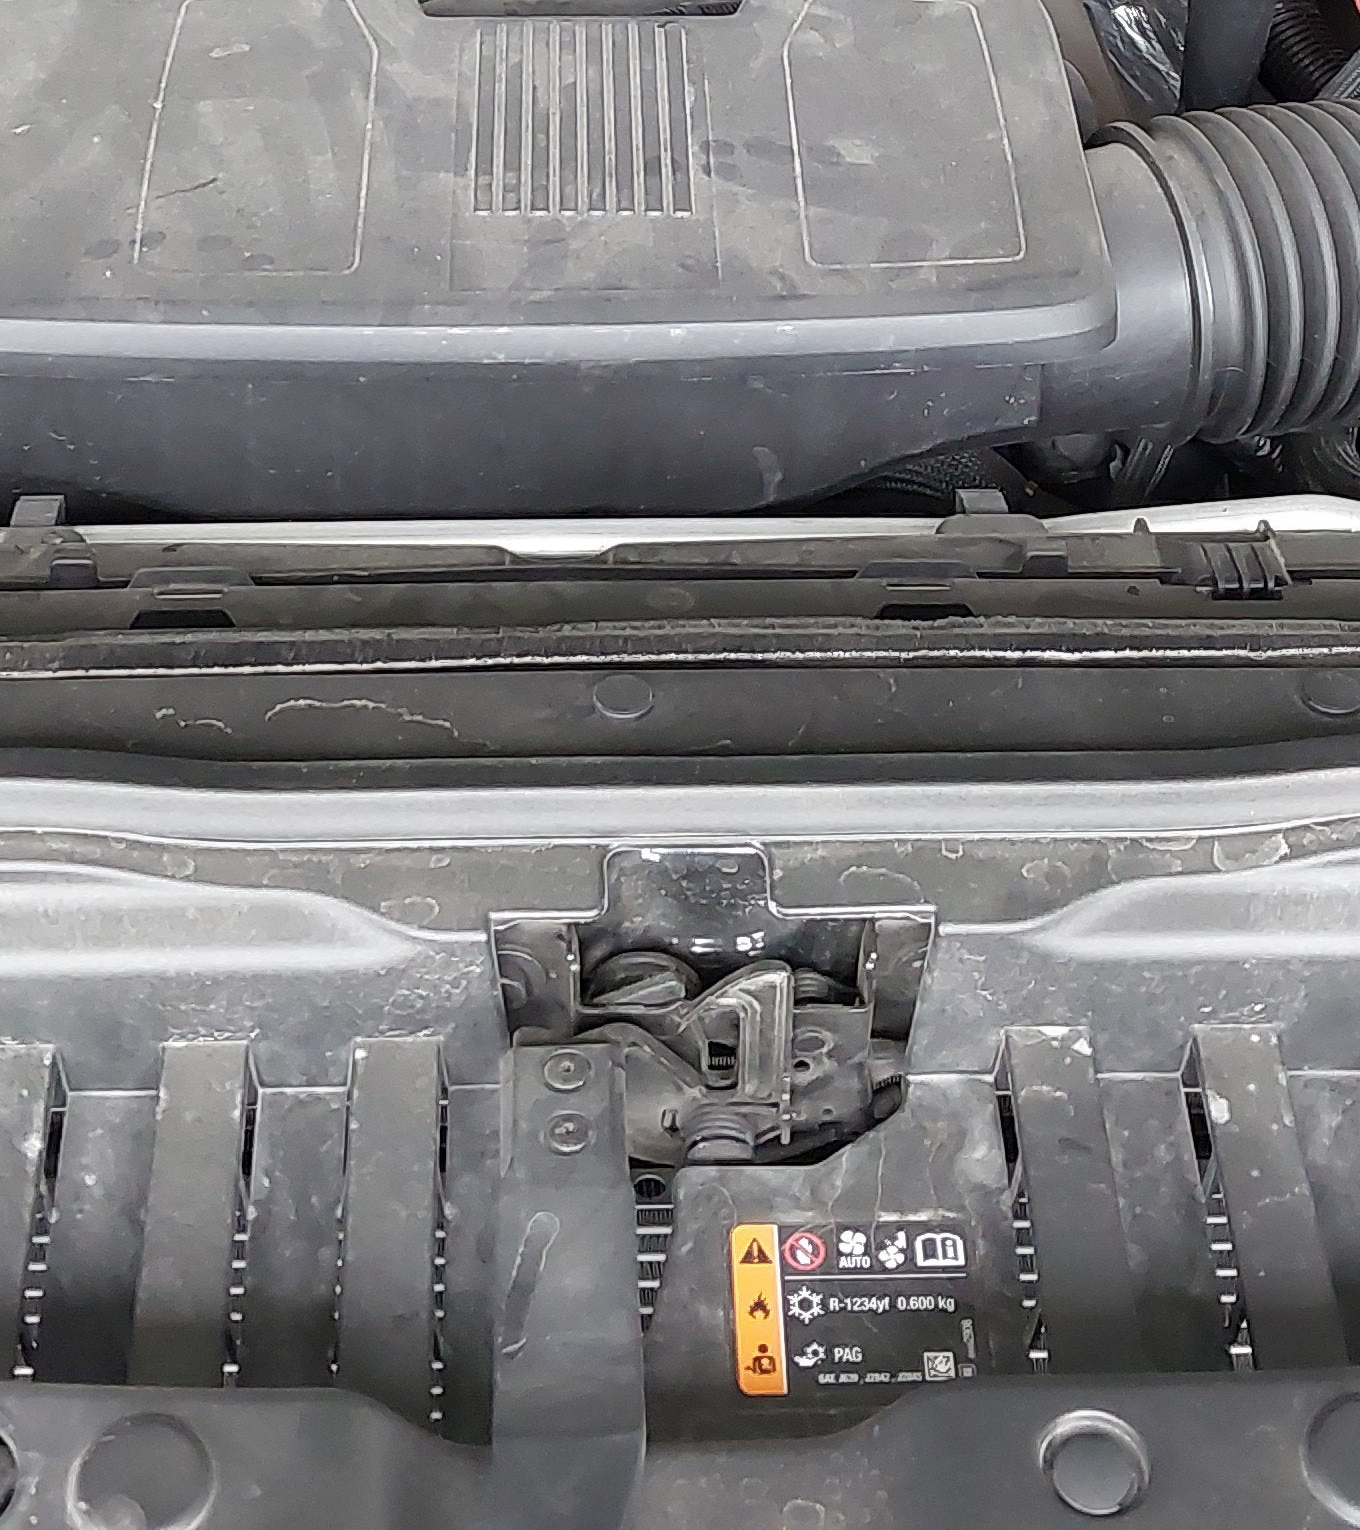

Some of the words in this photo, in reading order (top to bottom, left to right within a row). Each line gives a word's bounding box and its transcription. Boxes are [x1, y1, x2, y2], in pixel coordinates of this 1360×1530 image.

[839, 1256, 871, 1269] AUTO
[829, 1296, 890, 1314] R-1234yf
[897, 1296, 935, 1311] 0.600
[937, 1295, 955, 1312] kg
[833, 1347, 862, 1363] PAG
